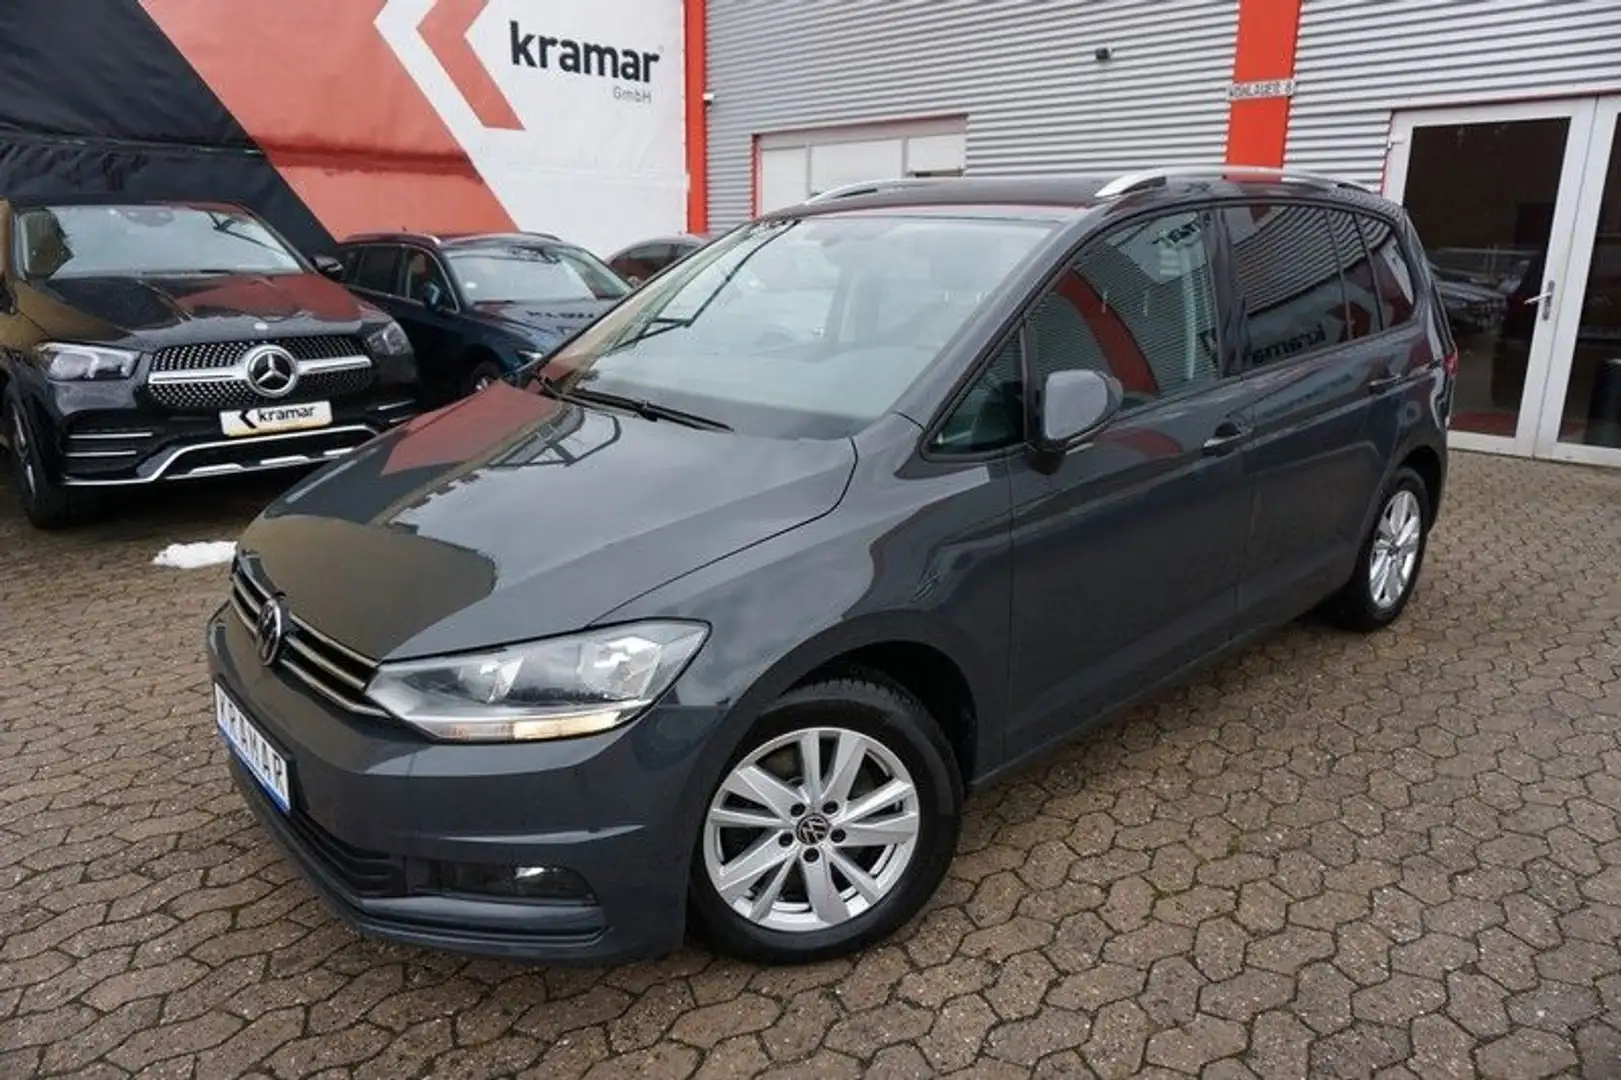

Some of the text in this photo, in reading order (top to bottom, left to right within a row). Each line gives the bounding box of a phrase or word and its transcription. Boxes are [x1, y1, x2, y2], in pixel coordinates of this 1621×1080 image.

[510, 20, 660, 82] kramar
[613, 86, 652, 104] GmbH
[257, 406, 316, 421] kramar
[219, 694, 288, 798] KRAMAR
